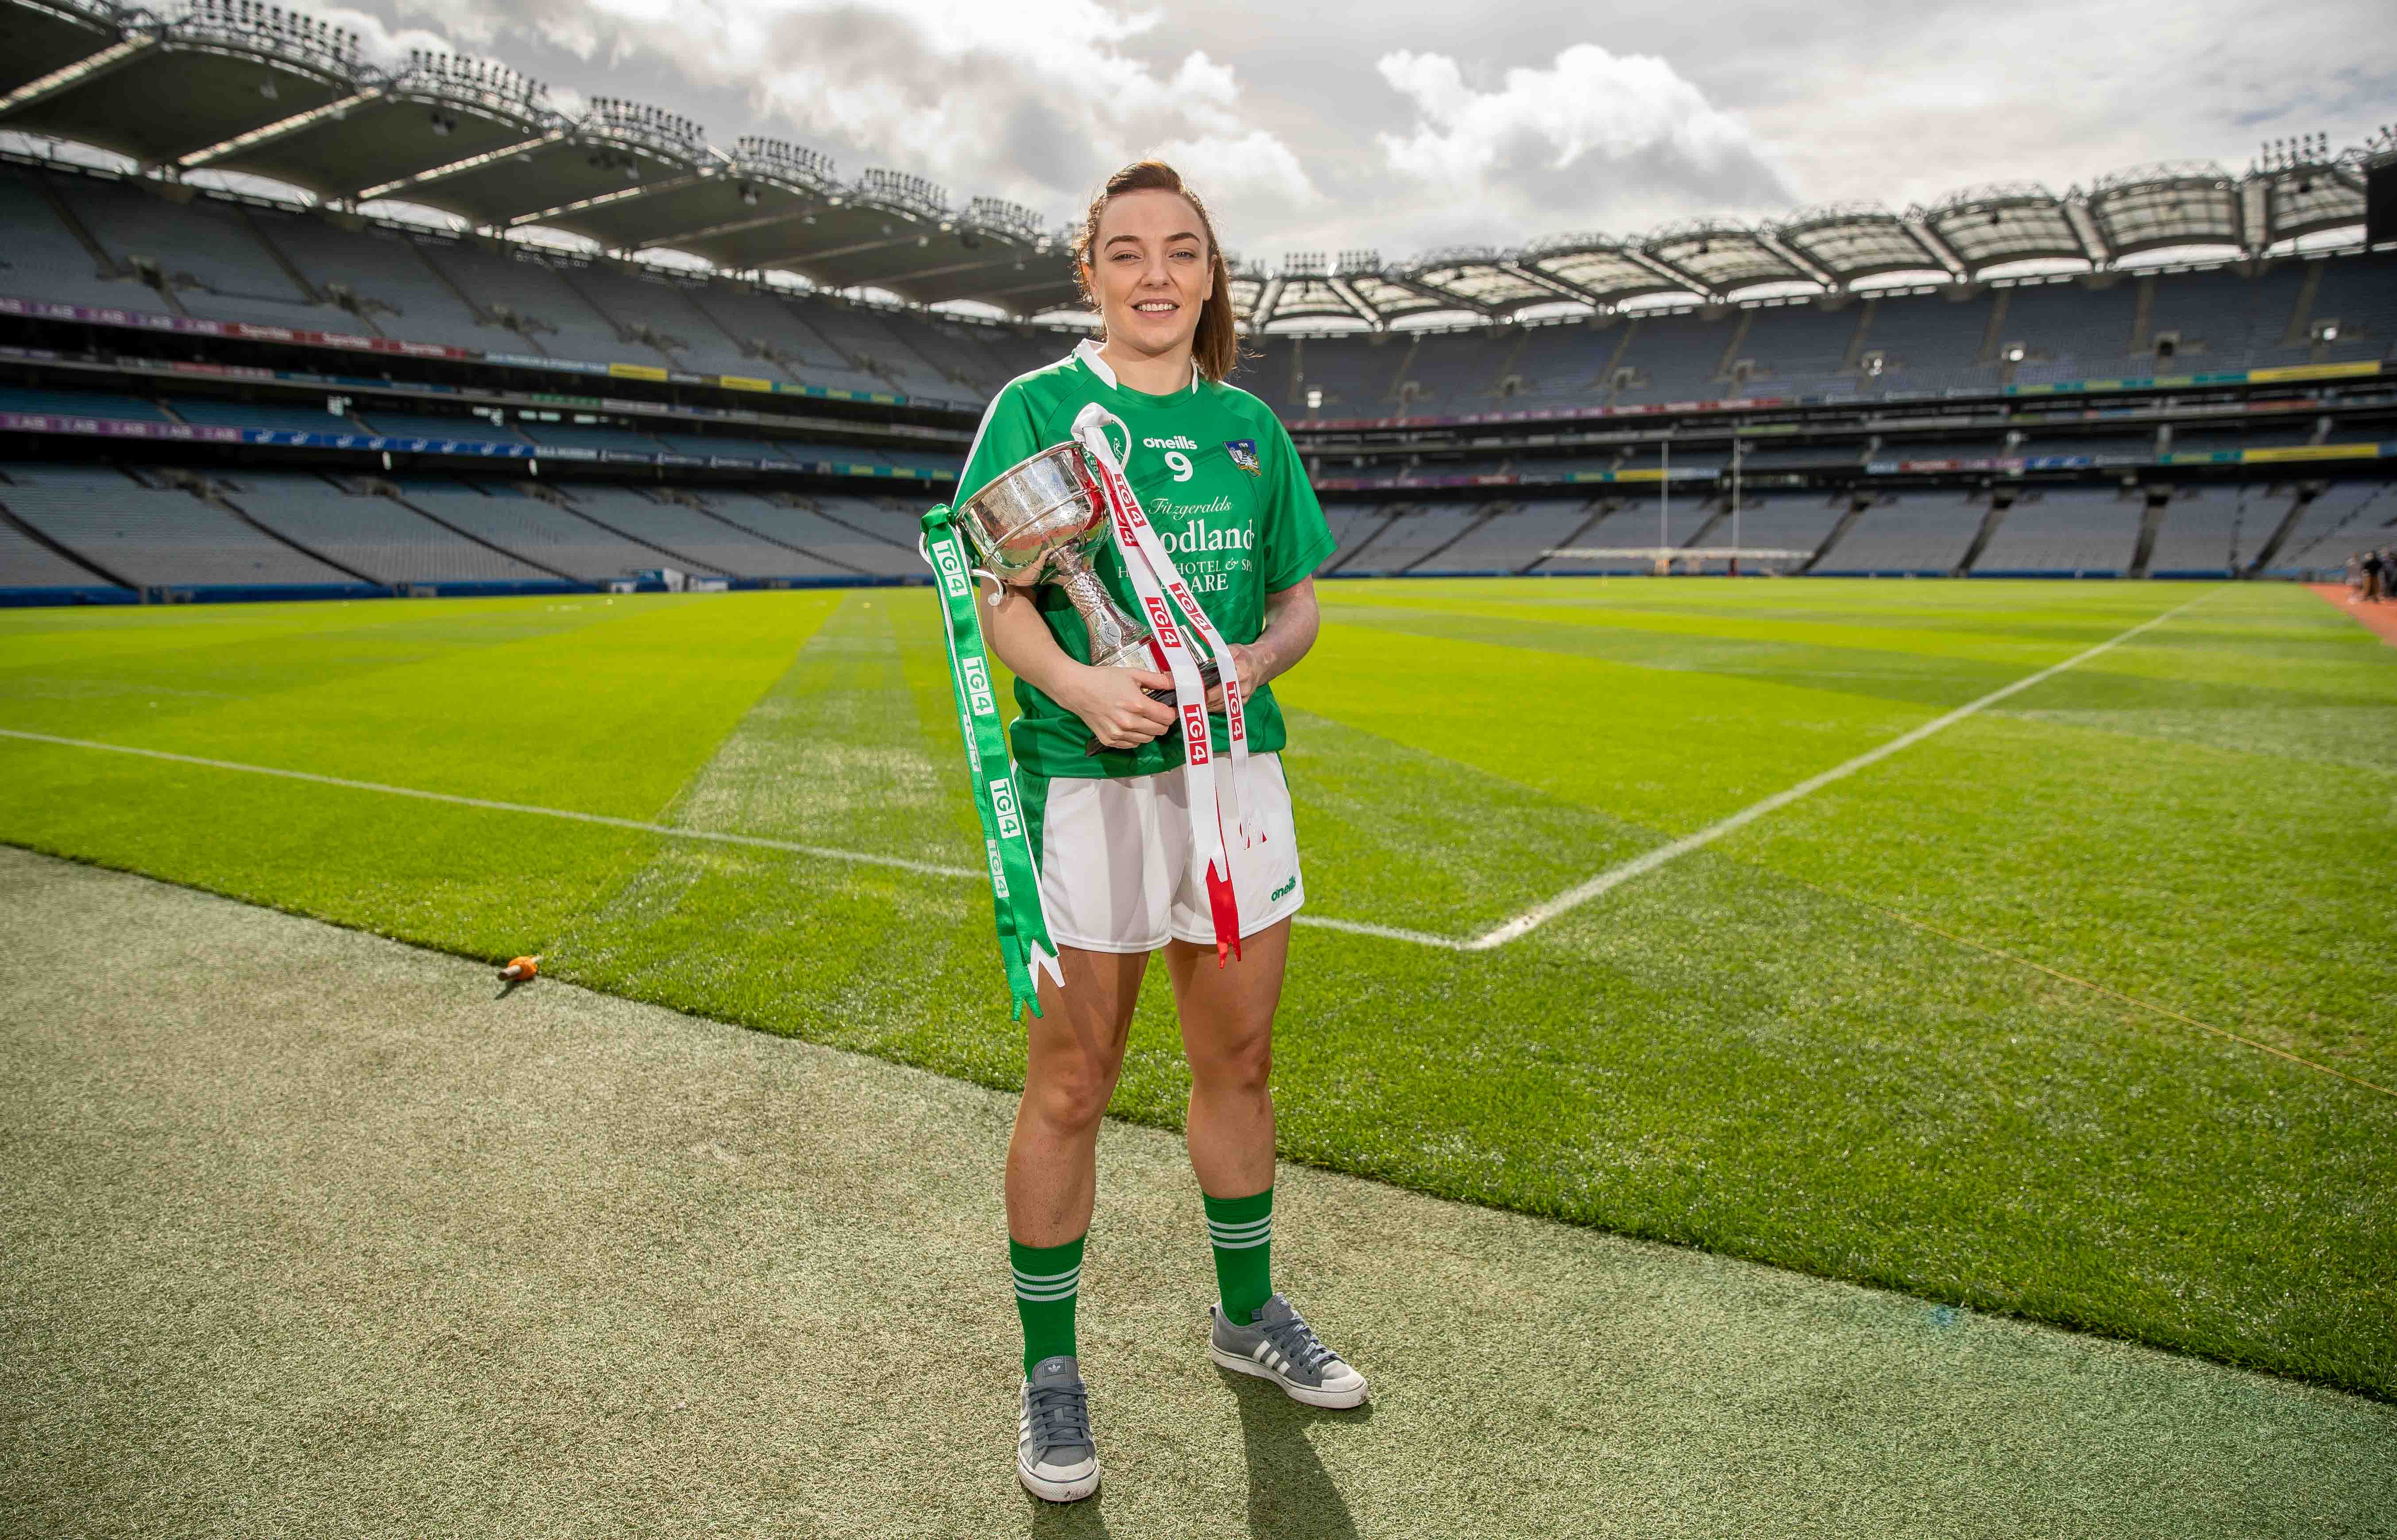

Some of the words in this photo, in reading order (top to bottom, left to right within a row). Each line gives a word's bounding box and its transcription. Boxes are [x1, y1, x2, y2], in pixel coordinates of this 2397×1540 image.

[1164, 451, 1193, 482] 9
[1117, 475, 1143, 525] TG4
[1148, 496, 1233, 521] Fitzgeralds
[1160, 518, 1255, 554] odland
[936, 542, 965, 593] TG4
[1174, 560, 1222, 575] HOTEL
[1225, 557, 1239, 571] &
[1149, 599, 1177, 645] TG4
[1174, 584, 1208, 631] TG4
[967, 659, 991, 711] TG4
[1186, 706, 1206, 762] TG4
[1228, 683, 1242, 738] TG4
[994, 781, 1018, 834] TG4
